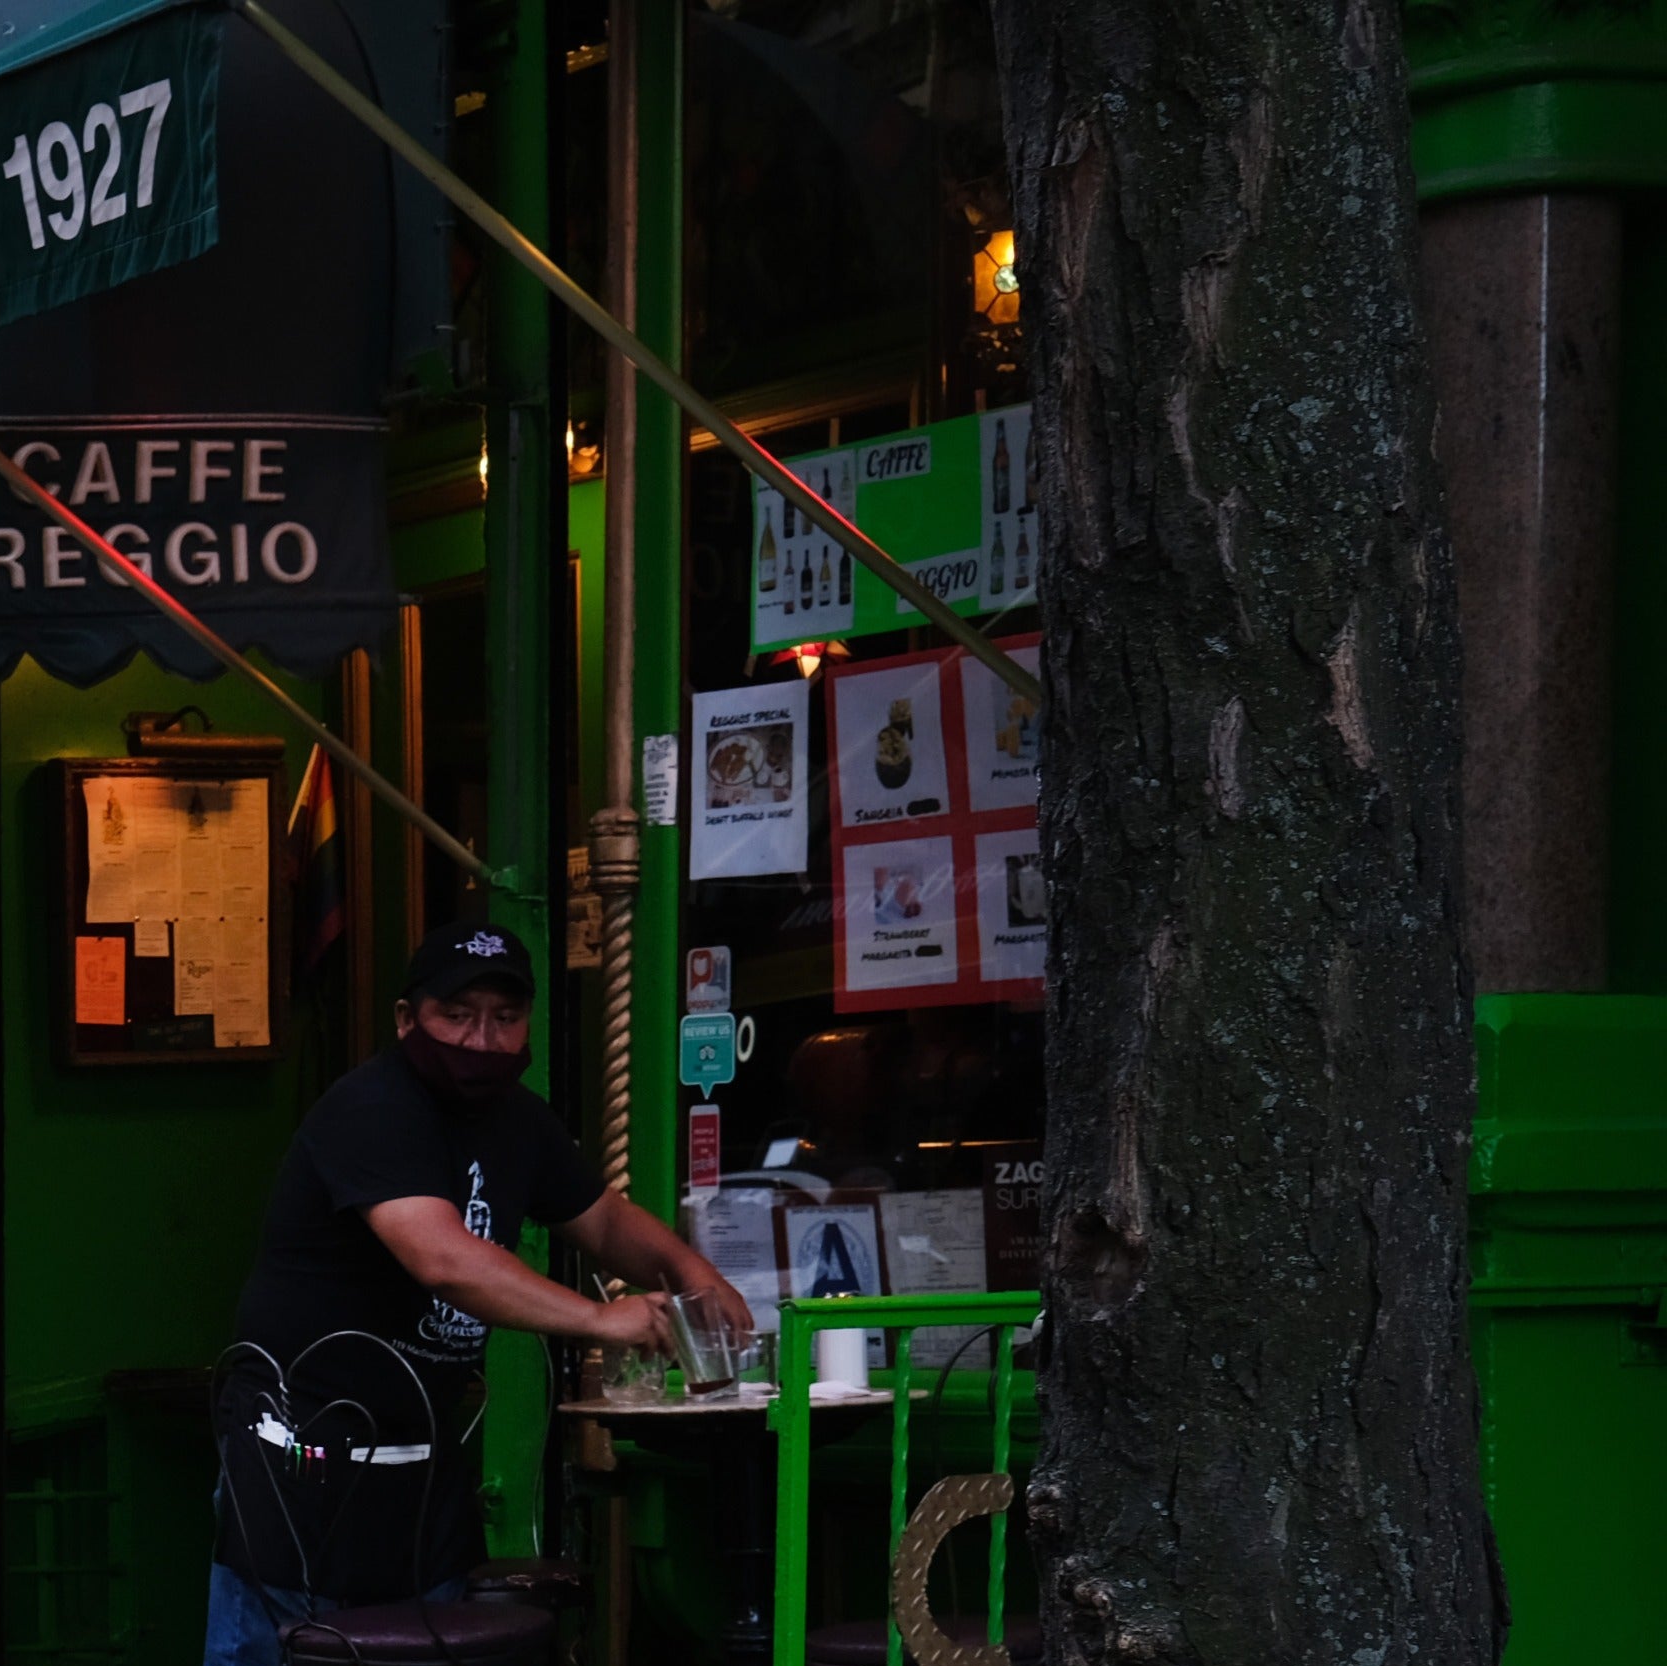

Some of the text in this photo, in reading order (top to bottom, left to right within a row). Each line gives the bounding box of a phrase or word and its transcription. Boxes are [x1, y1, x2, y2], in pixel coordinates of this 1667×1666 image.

[2, 78, 172, 250] 1927
[10, 438, 287, 505] CAFFE
[866, 442, 928, 479] CAFFE
[994, 1161, 1046, 1185] ZAG
[812, 1223, 860, 1298] A
